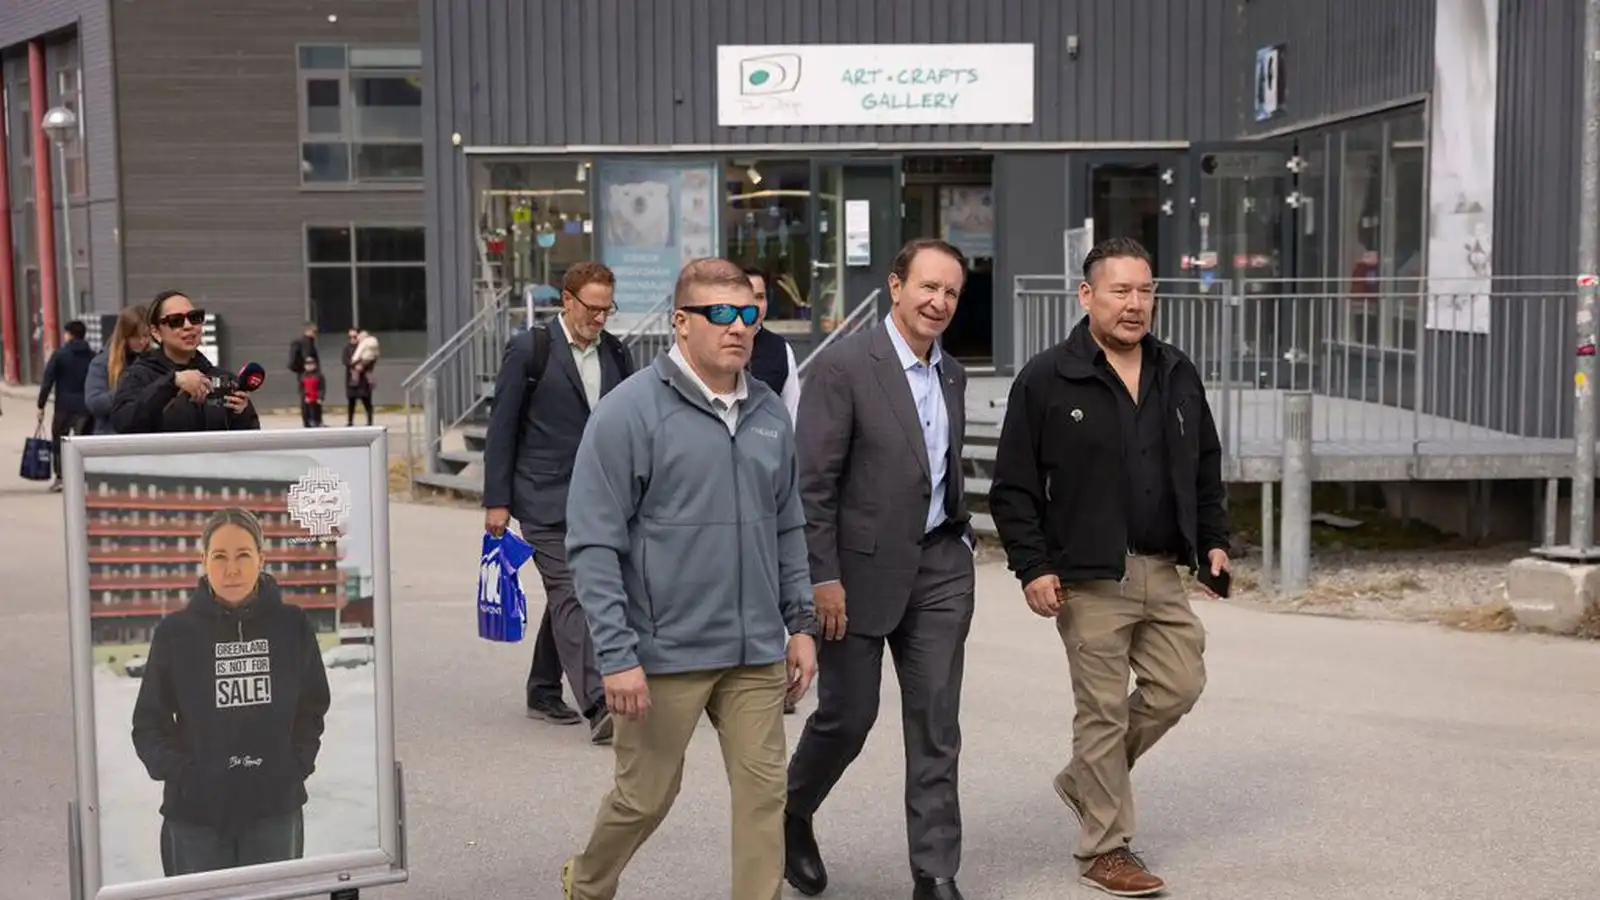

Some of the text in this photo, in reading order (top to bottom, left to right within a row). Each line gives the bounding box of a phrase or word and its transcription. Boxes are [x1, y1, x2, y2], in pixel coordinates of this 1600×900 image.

[841, 67, 979, 87] ART CRAFTS
[861, 92, 959, 110] GALLERY
[216, 640, 268, 656] GREENLAND
[216, 658, 269, 674] IS NOT FOR
[217, 677, 271, 705] SALE!
